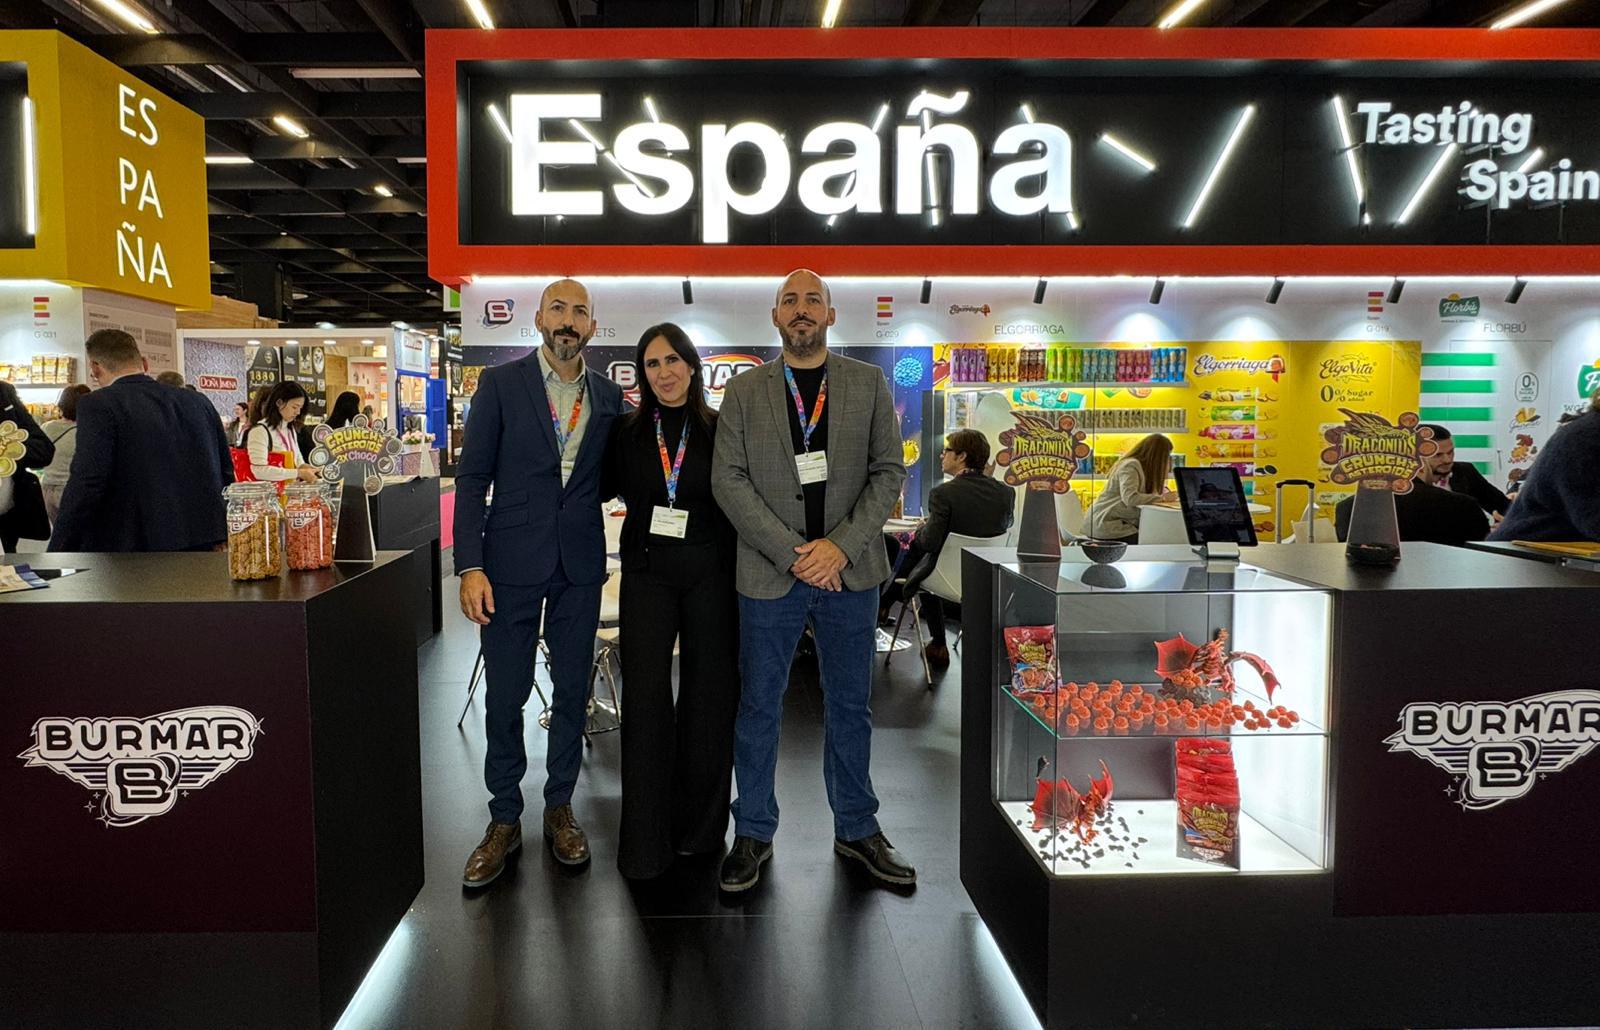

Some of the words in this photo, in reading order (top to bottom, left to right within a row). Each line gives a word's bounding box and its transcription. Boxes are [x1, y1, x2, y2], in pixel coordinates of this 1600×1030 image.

[119, 83, 158, 146] ES
[1357, 100, 1533, 154] Tasting
[510, 90, 1073, 243] España
[118, 156, 164, 219] PA
[1465, 158, 1600, 209] Spain
[116, 220, 173, 289] ÑA
[1442, 301, 1478, 314] Florbú
[994, 324, 1065, 336] ELGORRIAGA
[1482, 321, 1527, 334] FLORBÚ
[249, 370, 275, 382] 1880
[1193, 354, 1269, 376] Elgorriaga
[1319, 358, 1373, 379] ElgoVita
[1346, 389, 1374, 398] Sugar
[325, 429, 386, 449] CRUNCHY
[1013, 434, 1073, 459] DRACONIUS
[1342, 432, 1416, 458] DRACONIUS
[1012, 456, 1076, 475] CRUNCHY
[1018, 467, 1070, 480] ASTEROIDS
[1340, 454, 1418, 473] CRUNCHY
[1348, 465, 1413, 479] ASTEROIDS
[1410, 706, 1600, 737] BURMAR
[43, 722, 246, 753] BURMAR
[1476, 746, 1529, 788] B
[114, 762, 171, 804] B
